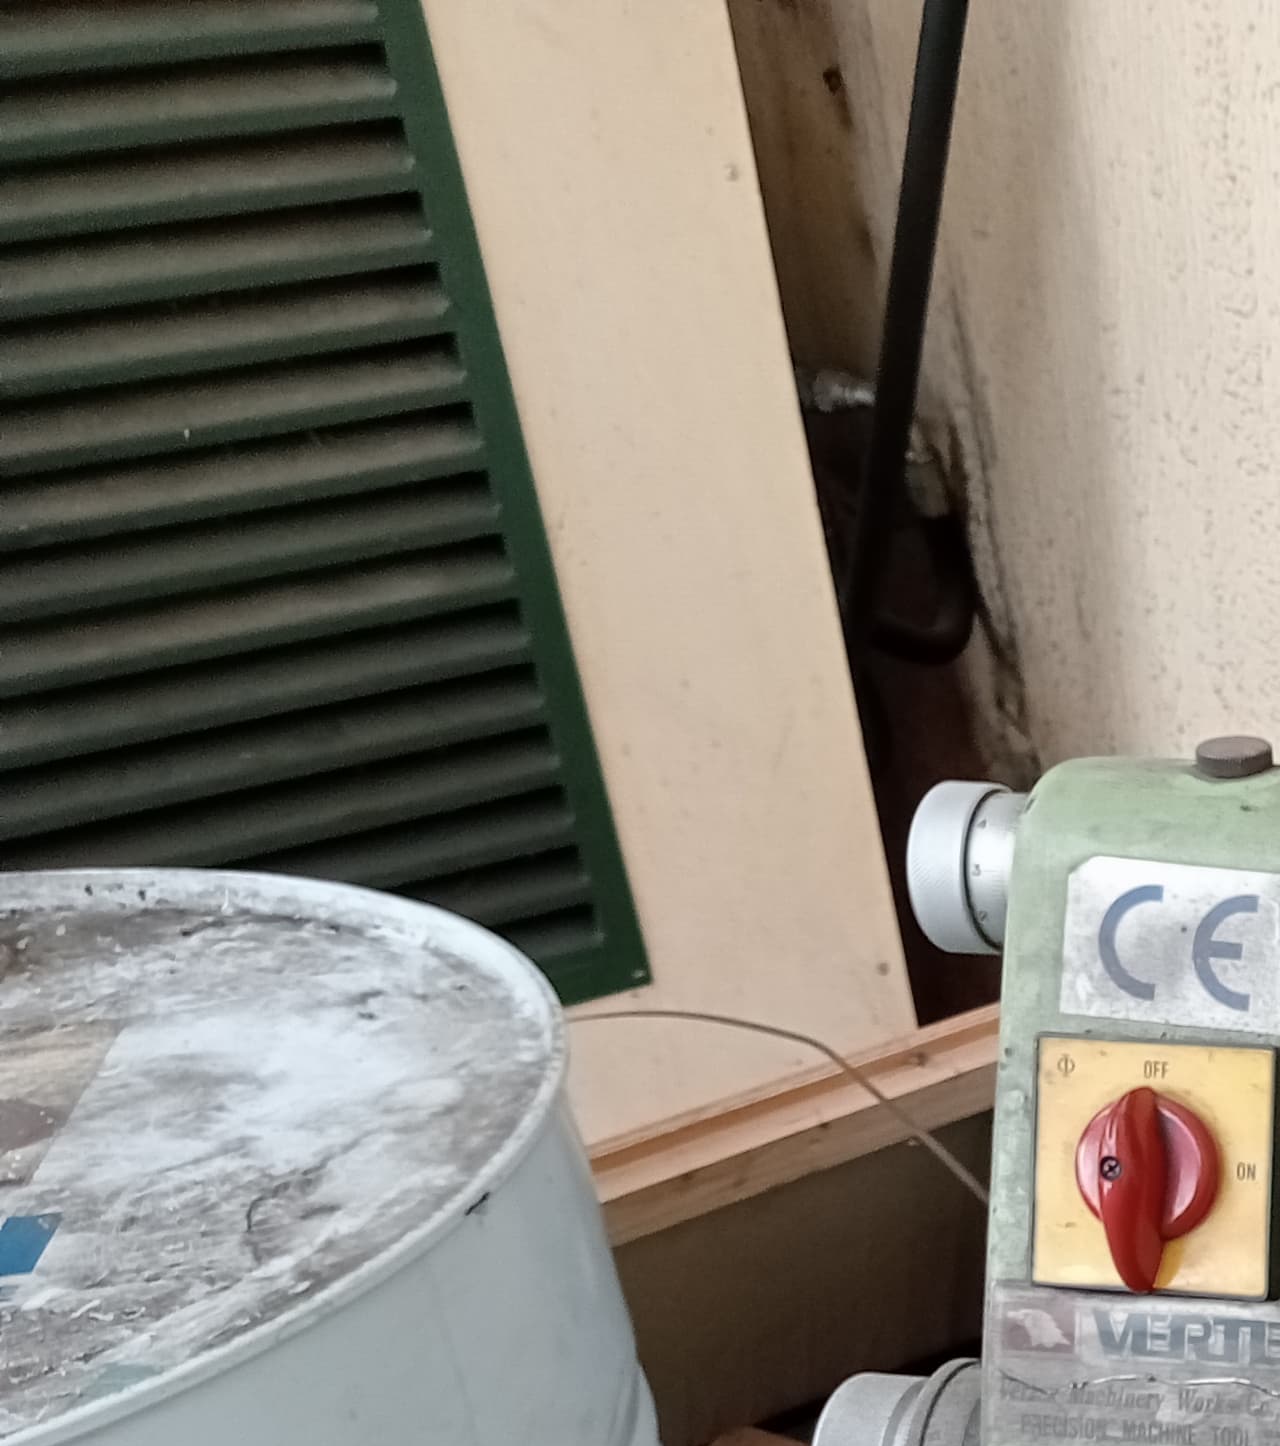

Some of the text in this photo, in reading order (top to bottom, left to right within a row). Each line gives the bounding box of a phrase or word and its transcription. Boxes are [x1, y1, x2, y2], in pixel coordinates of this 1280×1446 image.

[1100, 883, 1260, 1012] CE
[1143, 1060, 1169, 1080] OFF
[1236, 1162, 1257, 1181] ON
[1121, 1420, 1197, 1446] MACHINE
